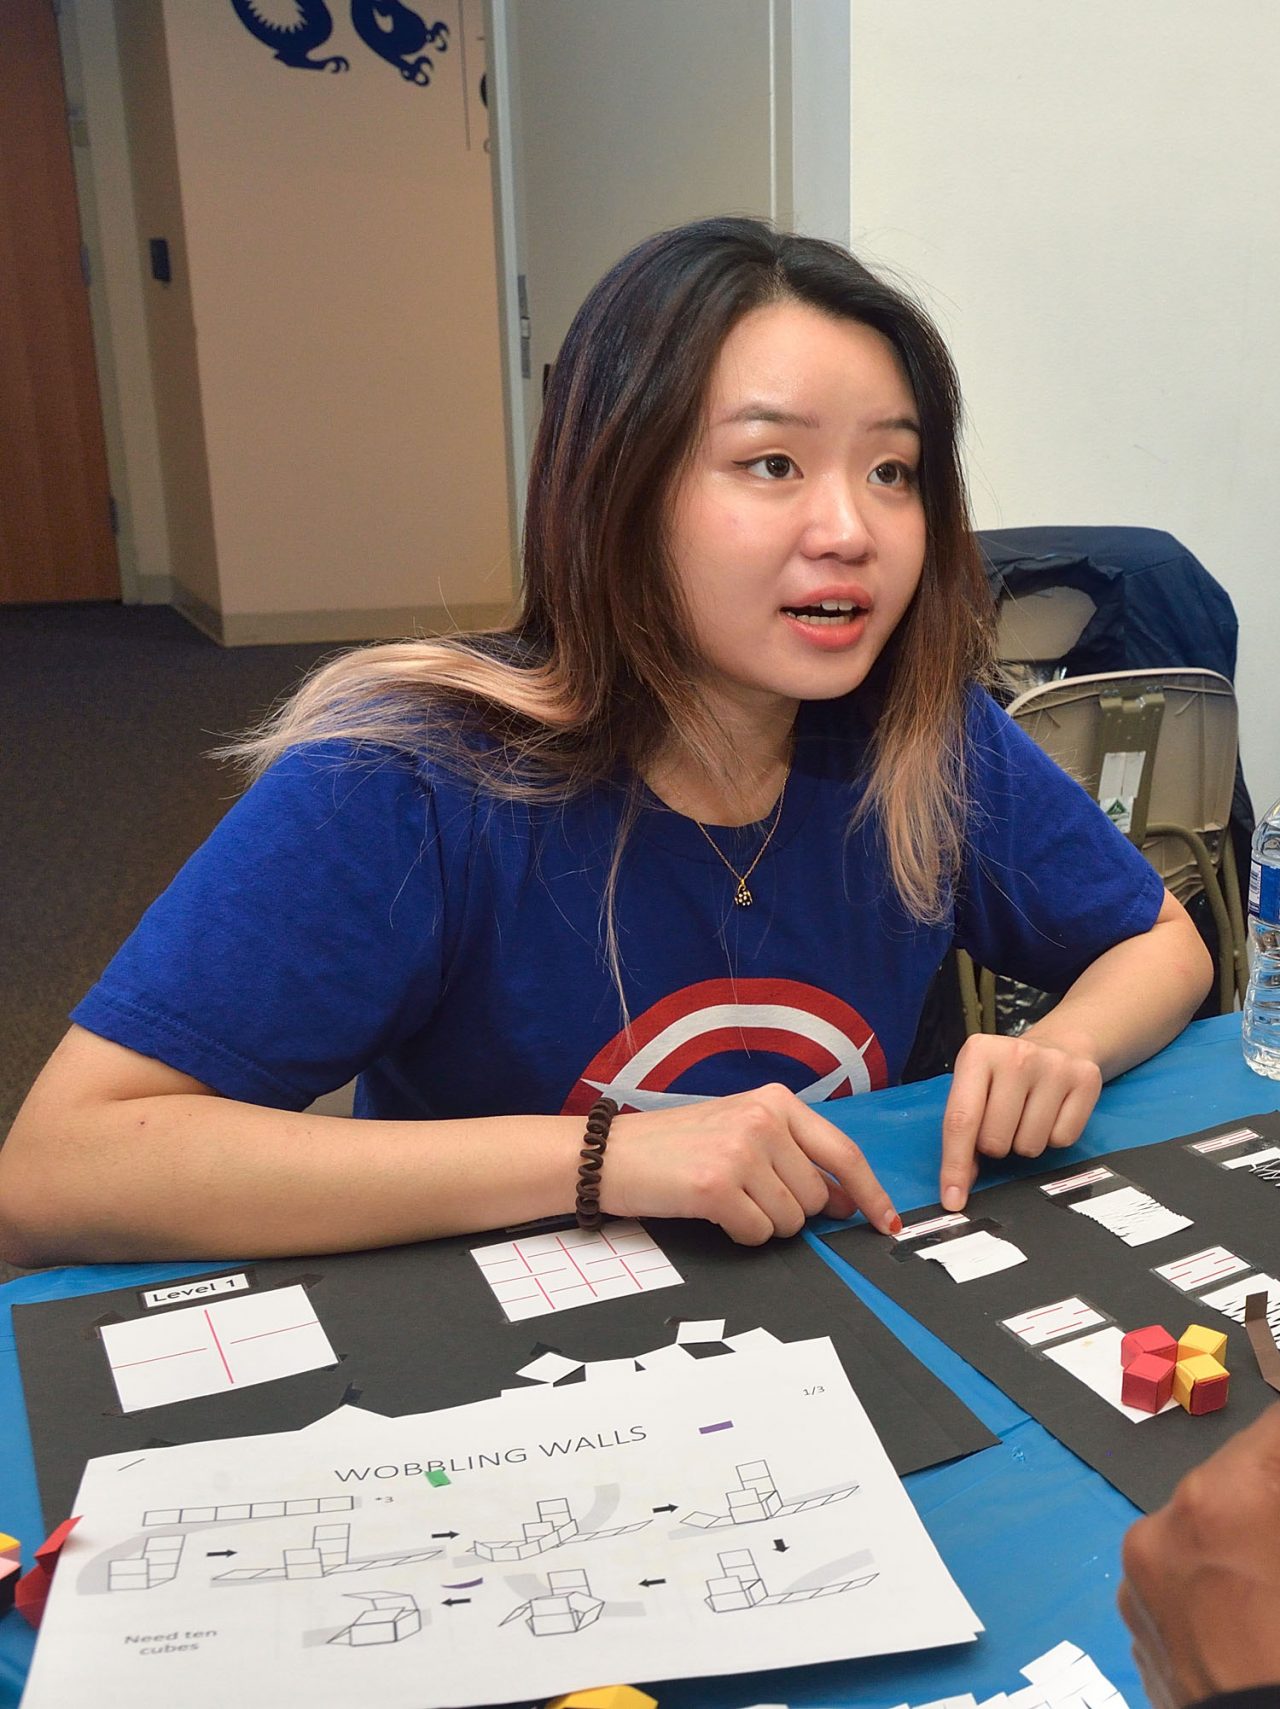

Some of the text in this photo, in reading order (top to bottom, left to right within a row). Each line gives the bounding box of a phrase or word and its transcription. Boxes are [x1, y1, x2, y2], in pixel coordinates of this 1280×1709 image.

[153, 1279, 235, 1302] Level 1
[802, 1385, 825, 1396] 1/3
[334, 1425, 647, 1483] WOBBLING WALLS
[124, 1630, 217, 1644] Need ten
[139, 1643, 200, 1656] cubes
